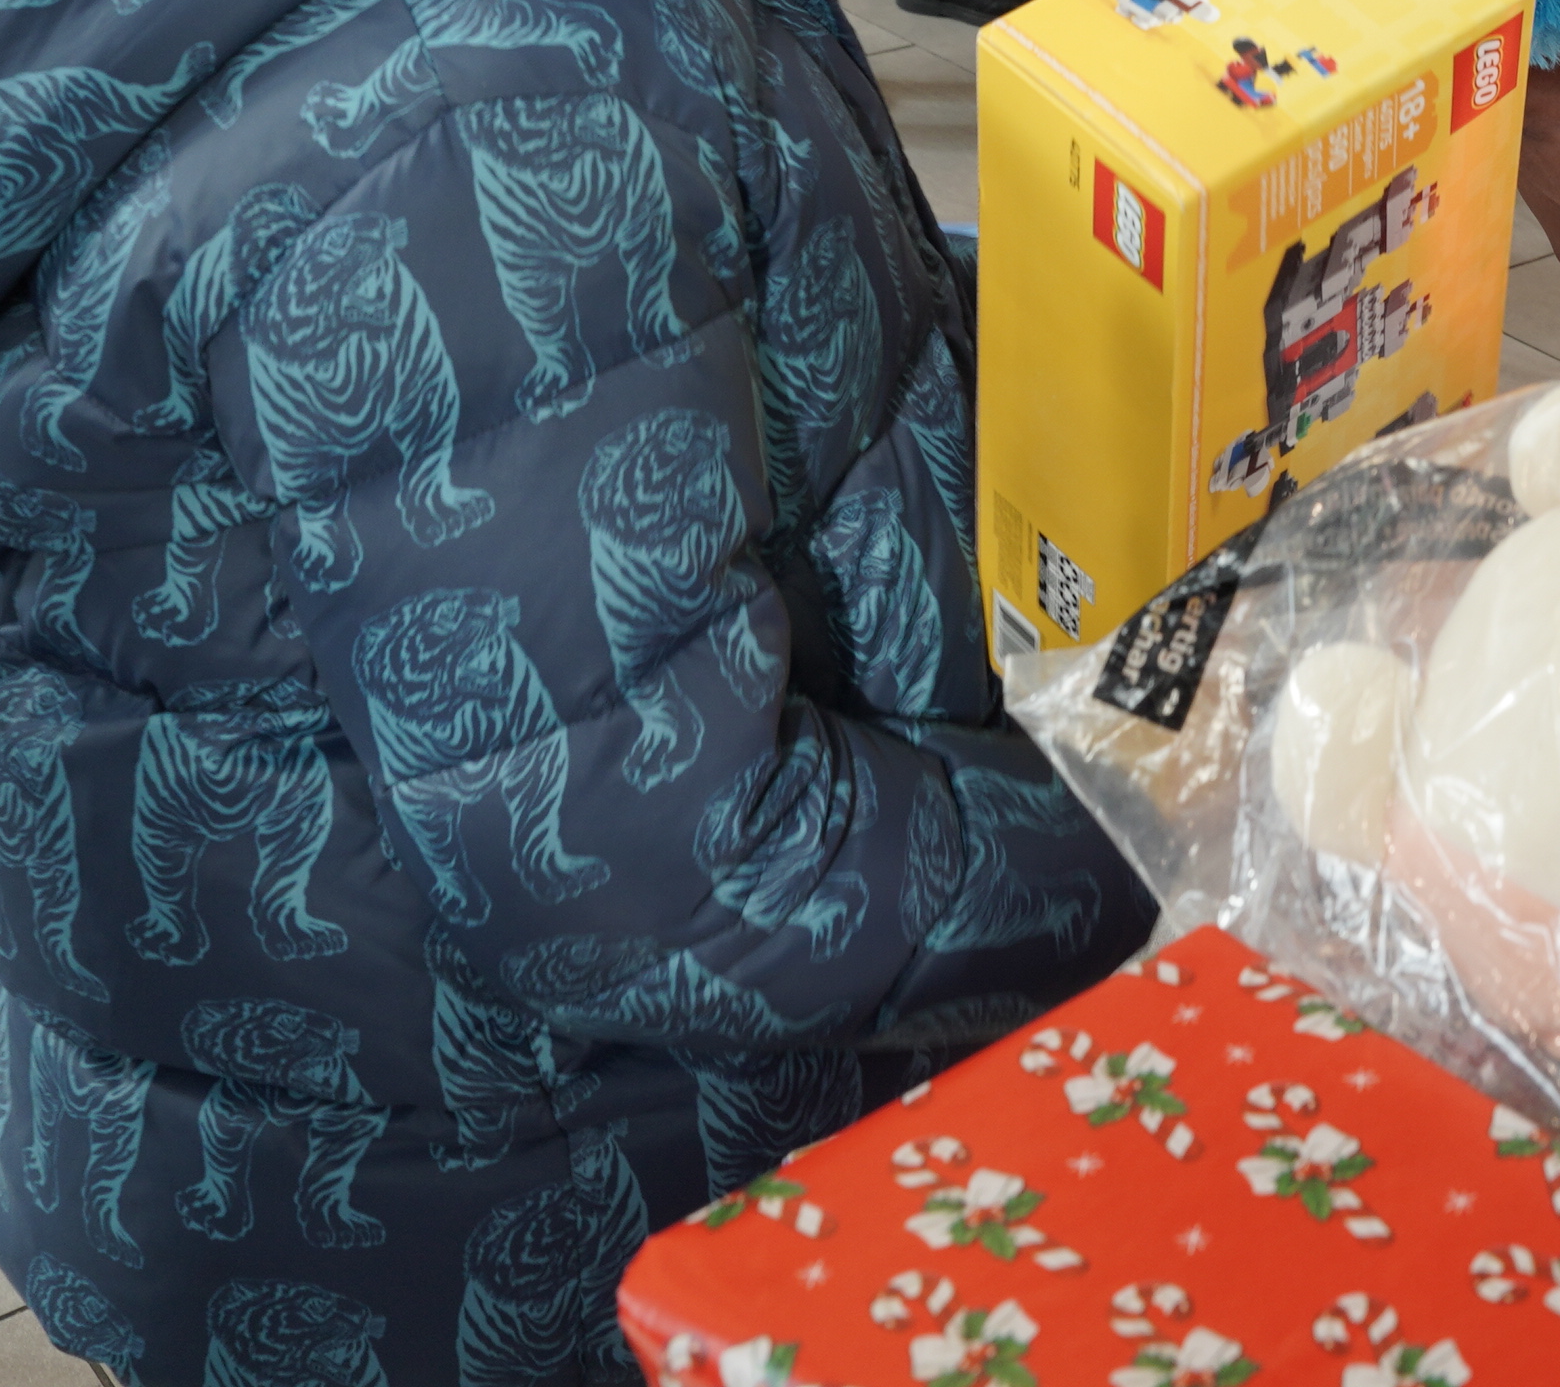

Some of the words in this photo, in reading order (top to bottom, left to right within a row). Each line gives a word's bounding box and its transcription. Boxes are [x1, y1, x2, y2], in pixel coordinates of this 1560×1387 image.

[1474, 39, 1501, 105] LEGO
[1399, 78, 1426, 142] 18+
[1116, 180, 1143, 269] LEGO
